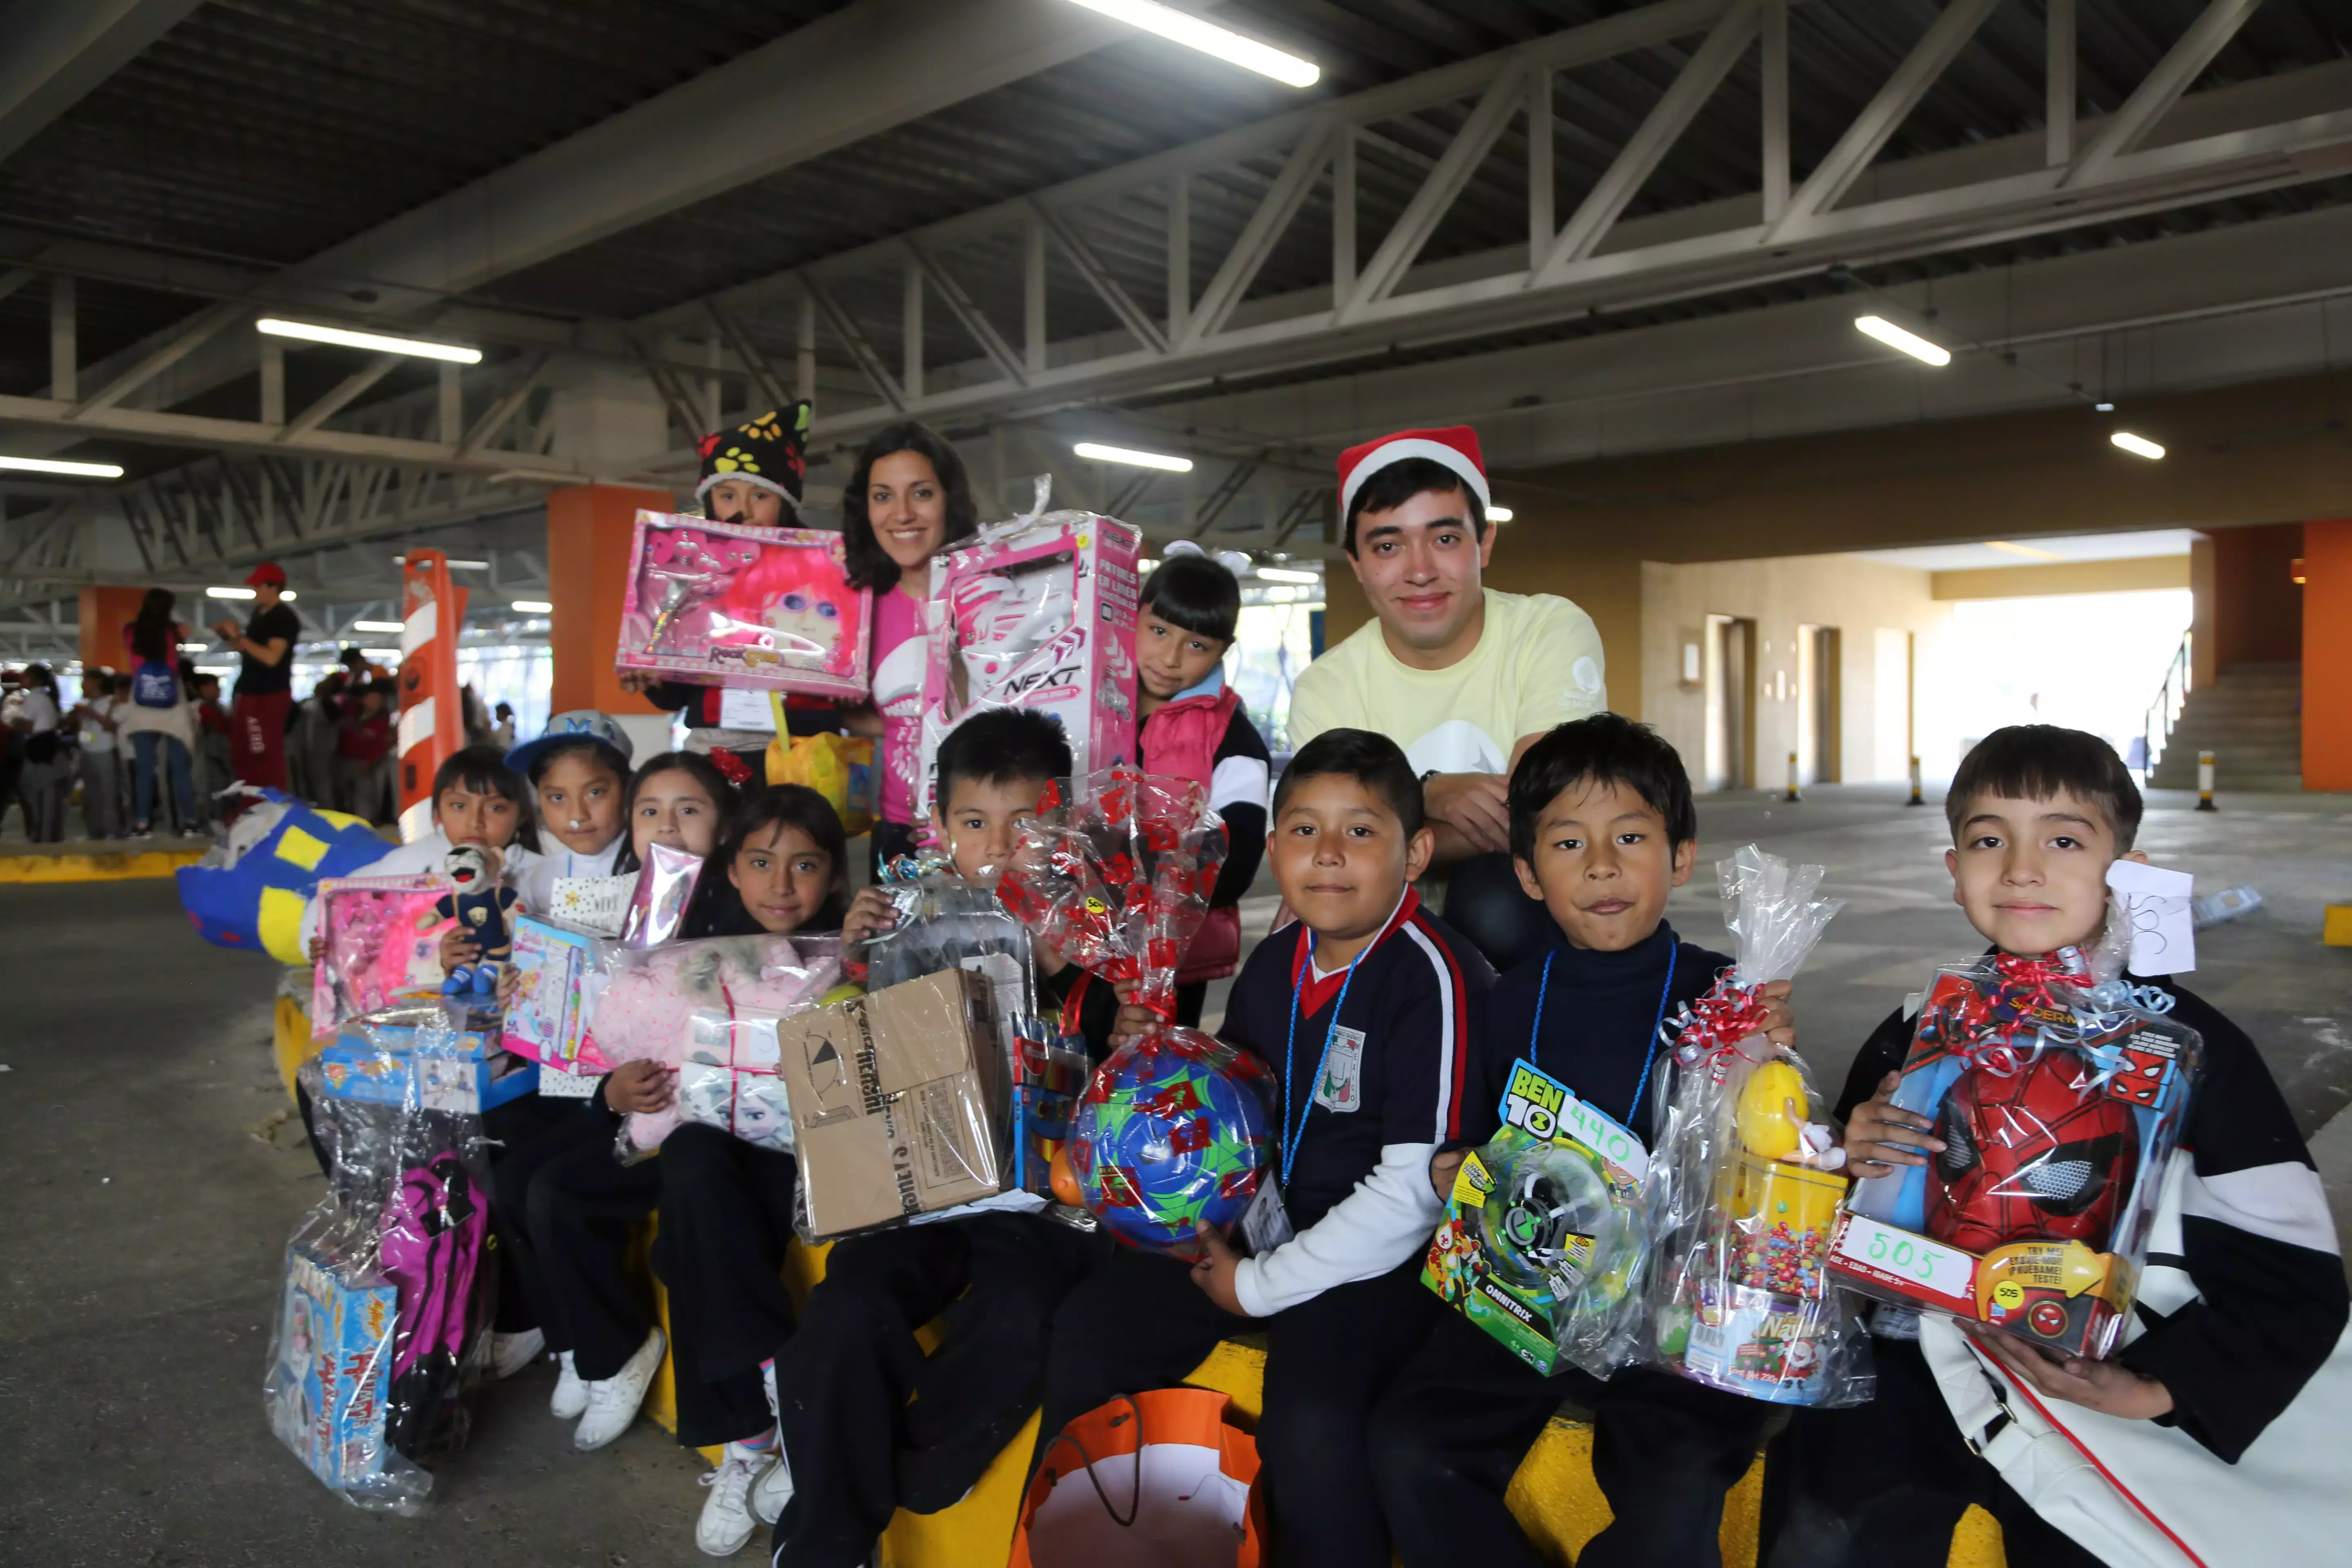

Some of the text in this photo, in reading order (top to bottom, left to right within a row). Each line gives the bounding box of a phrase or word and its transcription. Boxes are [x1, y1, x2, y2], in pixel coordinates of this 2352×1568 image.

[1003, 664, 1082, 695] NEXT
[1510, 1067, 1564, 1114] BEN
[1507, 1094, 1557, 1138] 10
[1570, 1105, 1630, 1162] 440
[1829, 1254, 1844, 1265] AGE
[1869, 1232, 1946, 1279] 505
[2028, 1247, 2062, 1256] TRY ME!
[2034, 1274, 2062, 1285] TESTE!
[1485, 1284, 1532, 1322] OMNITRIX
